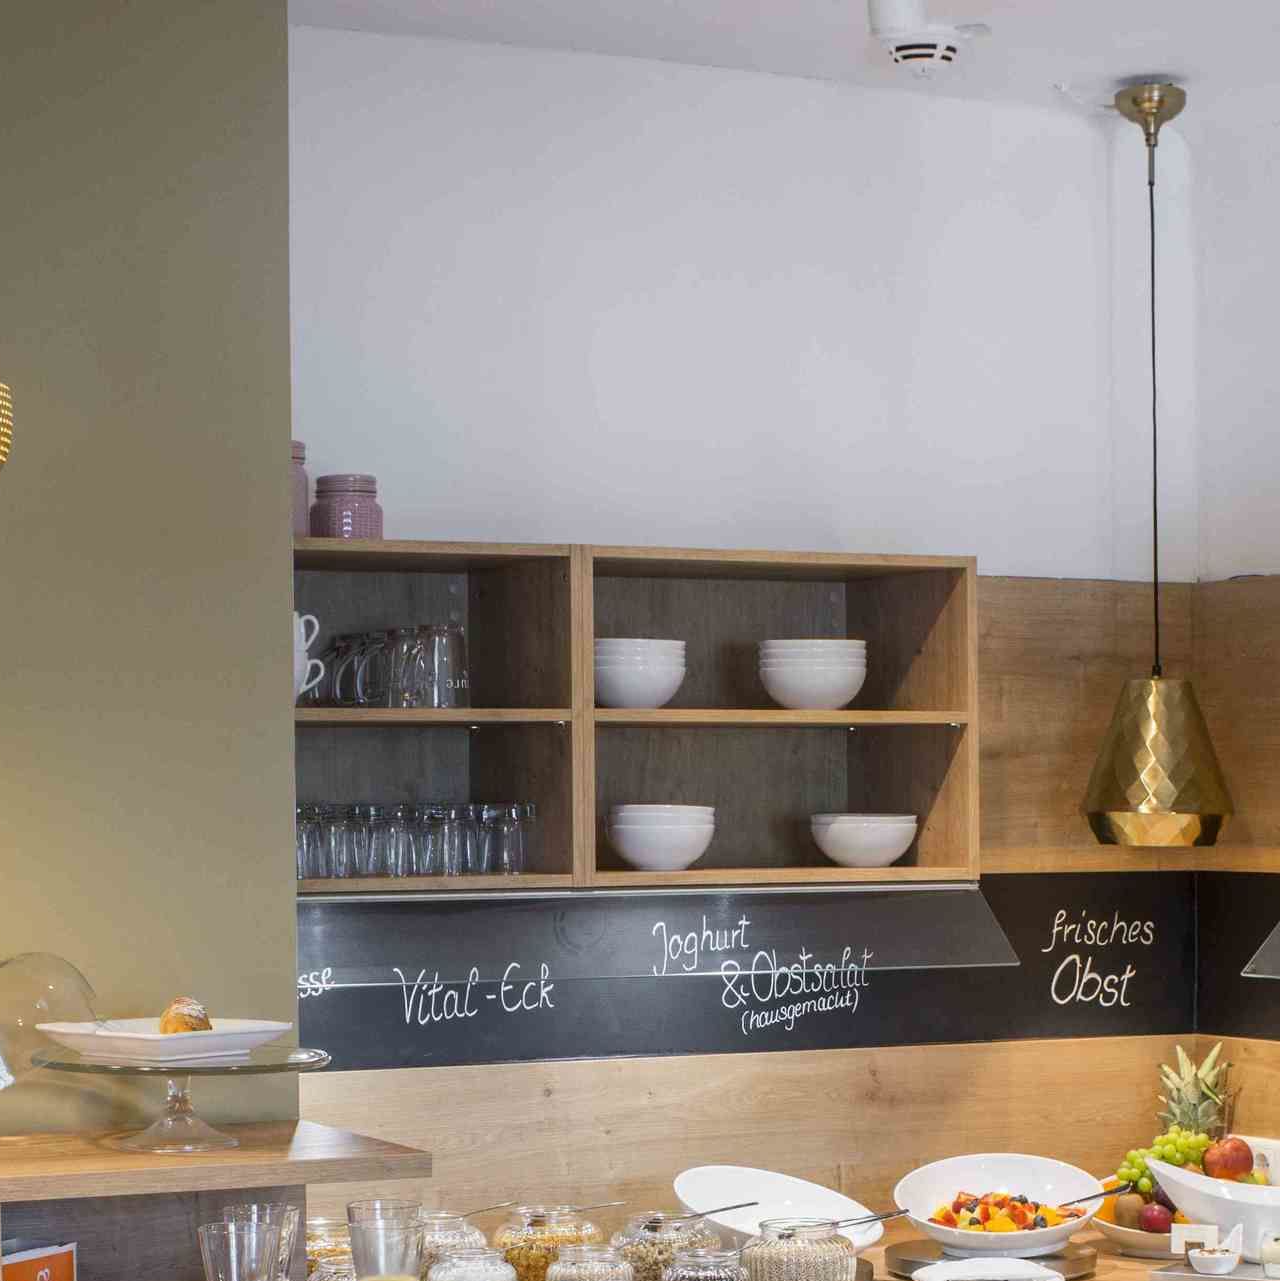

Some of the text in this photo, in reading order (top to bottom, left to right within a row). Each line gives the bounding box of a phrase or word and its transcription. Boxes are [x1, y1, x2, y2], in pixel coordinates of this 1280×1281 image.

[651, 913, 751, 977] Joghurt
[296, 967, 337, 999] sse
[720, 945, 874, 1009] & Obstsalat
[1049, 953, 1138, 1007] Obst
[740, 986, 860, 1036] (hausgemacht)
